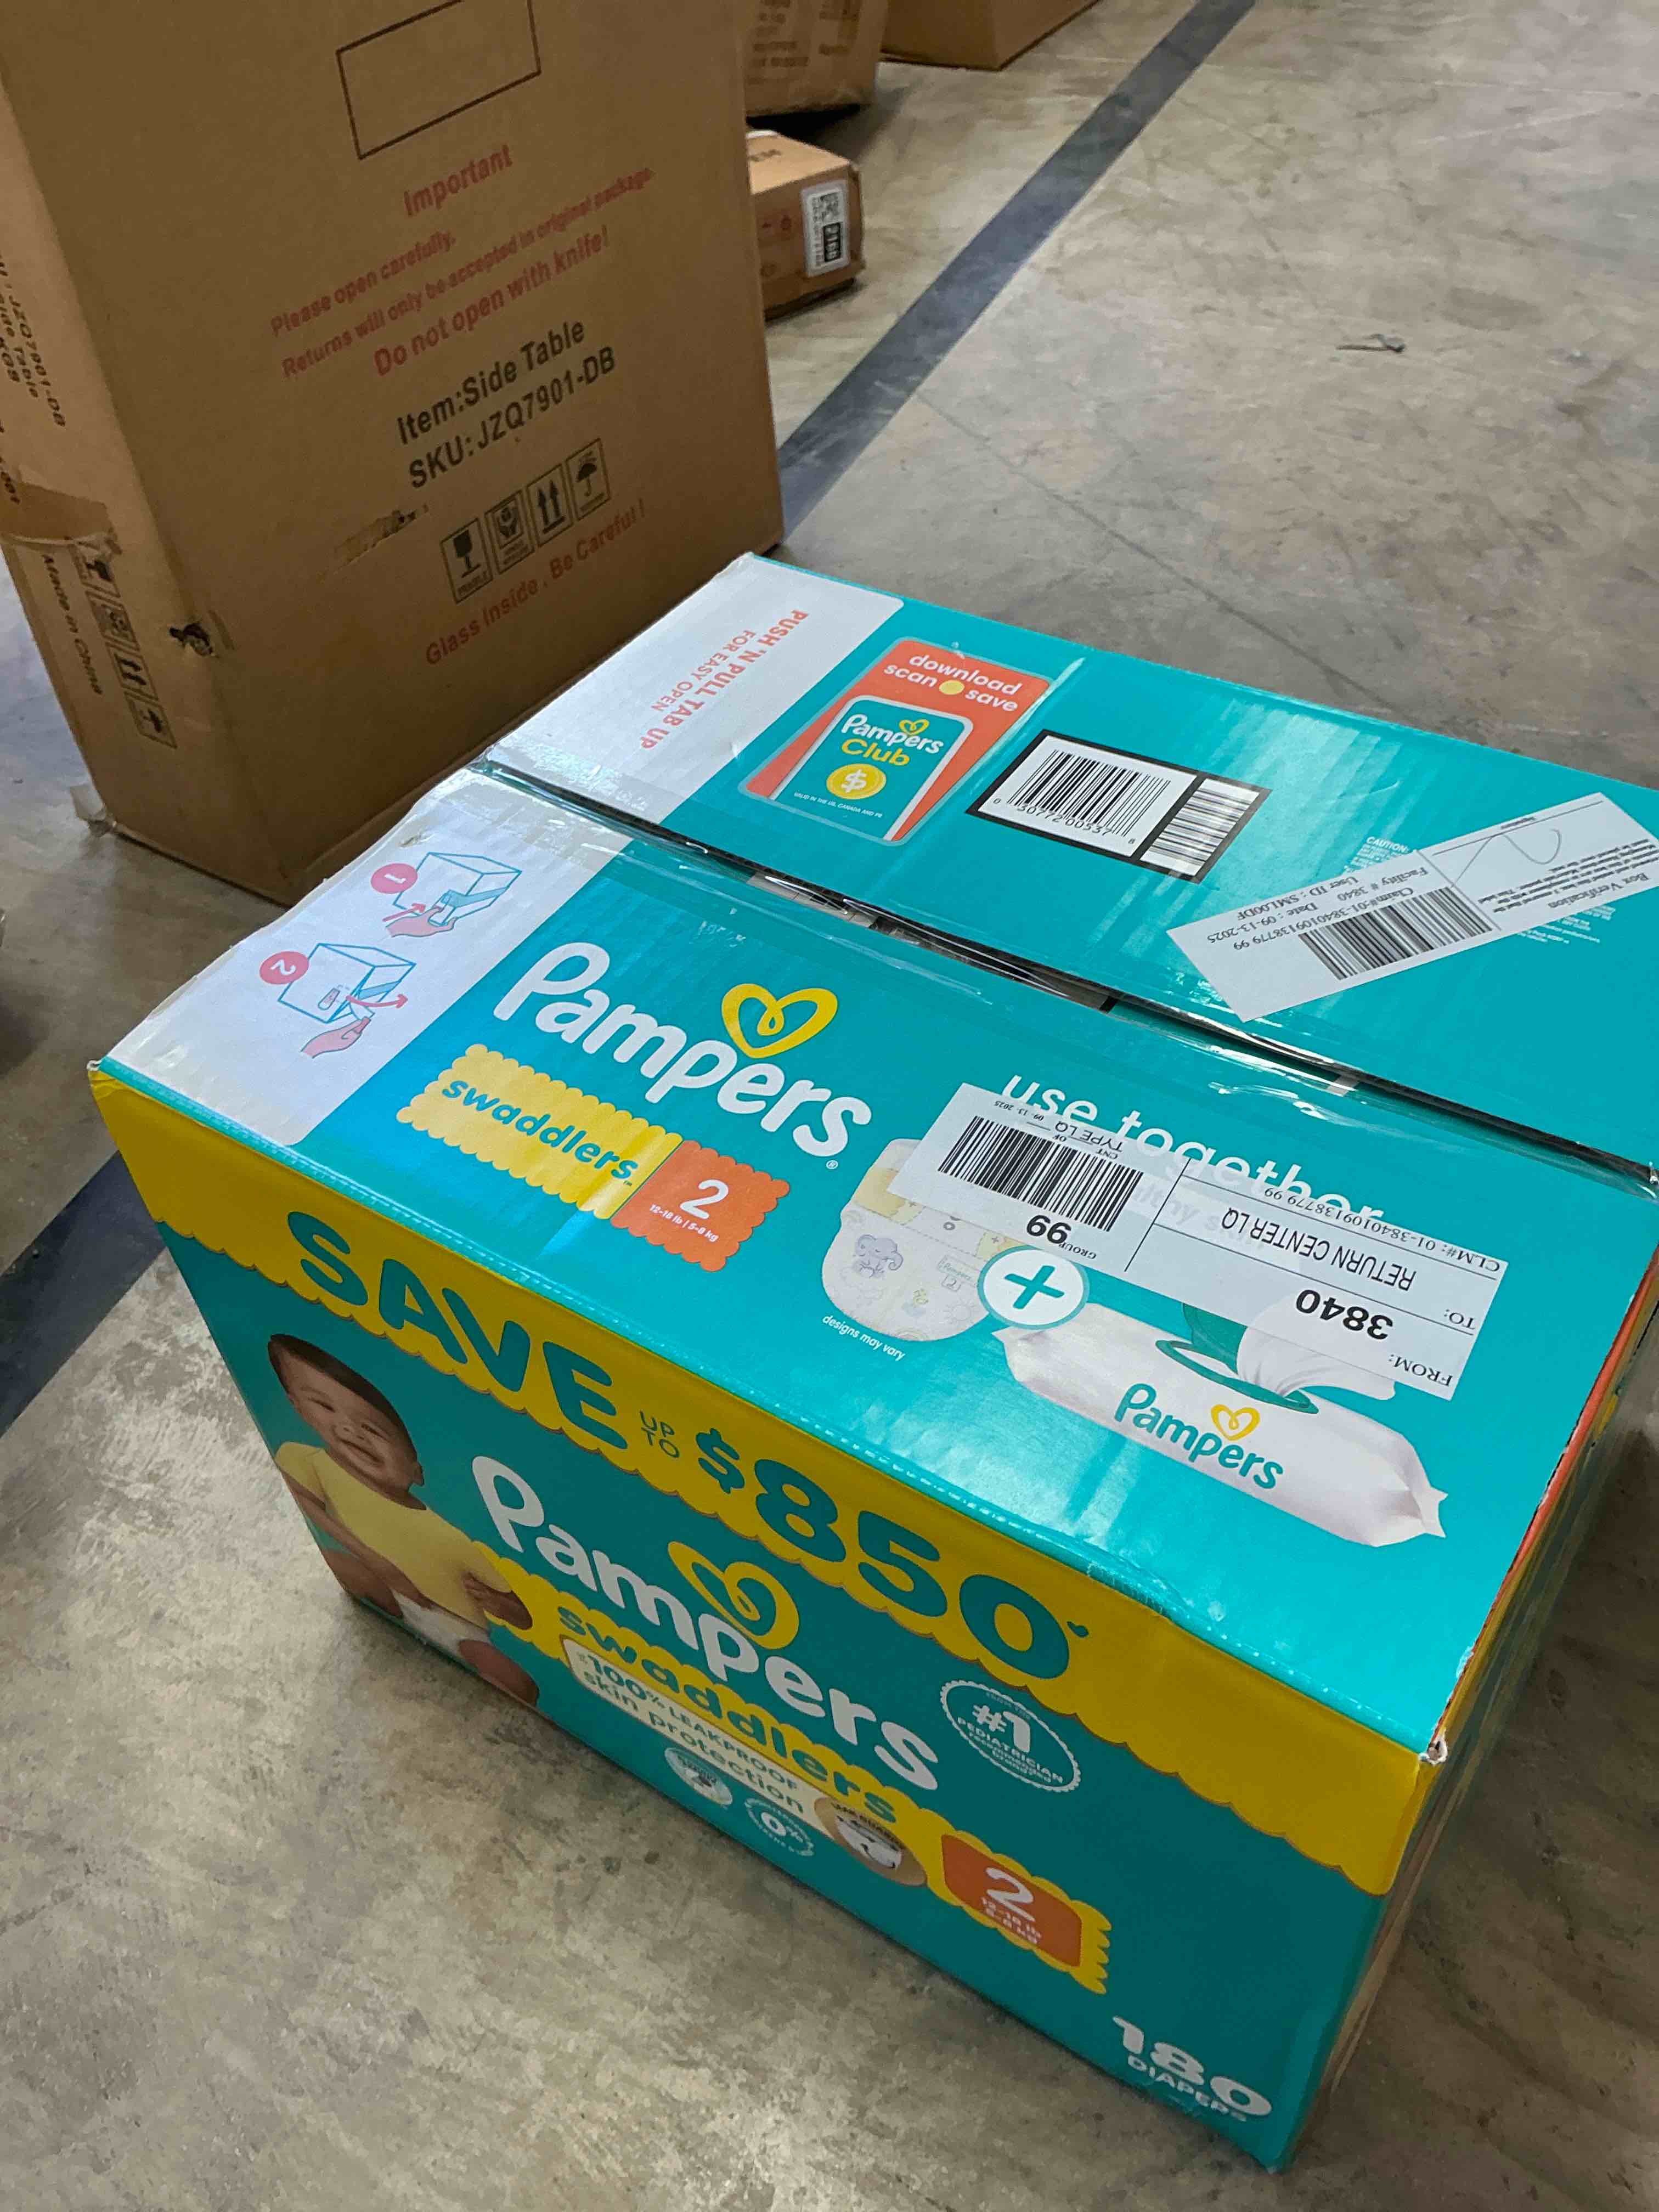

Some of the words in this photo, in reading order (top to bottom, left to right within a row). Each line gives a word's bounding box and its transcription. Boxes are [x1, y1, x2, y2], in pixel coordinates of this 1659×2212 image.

[404, 144, 513, 216] Important
[271, 296, 331, 337] Please
[334, 271, 377, 303] open
[281, 330, 353, 377] Returns
[355, 308, 386, 337] will
[387, 292, 422, 322] only
[425, 279, 446, 300] be
[448, 234, 517, 287] accepted
[374, 345, 407, 376] Do
[412, 317, 449, 356] not
[452, 289, 504, 331] open
[507, 260, 552, 300] with
[553, 224, 609, 274] knife!
[521, 320, 585, 373] Table
[426, 617, 480, 664] Glass
[483, 579, 538, 627] Inside
[549, 556, 573, 580] Be
[721, 629, 756, 651] FOR
[757, 609, 810, 646] PUSH
[690, 652, 727, 680] EASY
[695, 662, 746, 696] PULL
[909, 653, 1023, 696] download
[651, 681, 693, 712] OPEN
[883, 663, 939, 688] scan
[964, 689, 1018, 712] save
[663, 699, 706, 727] TAB
[640, 727, 670, 749] UP
[841, 713, 945, 754] Pampers
[841, 738, 910, 766] Club
[838, 803, 861, 813] CANADA
[1016, 803, 1063, 823] 30772
[1309, 886, 1328, 897] ID
[1329, 876, 1359, 890] User
[1380, 867, 1429, 887] Facility
[1625, 872, 1650, 885] Box
[1288, 901, 1318, 916] Date
[1337, 888, 1369, 901] 3840
[1548, 882, 1623, 909] Verification
[1206, 915, 1278, 944] 09-13-2025
[1233, 937, 1250, 951] 99
[270, 959, 296, 975] 2
[493, 941, 872, 1157] Pampers
[994, 1099, 1014, 1111] 2025
[1001, 1075, 1098, 1123] use
[442, 1079, 639, 1180] swaddlers
[1055, 1121, 1079, 1137] LQ
[1080, 1130, 1123, 1152] TYPE
[1096, 1148, 1119, 1160] CNT
[680, 1179, 729, 1219] 2
[1264, 1186, 1283, 1201] 99
[673, 1214, 684, 1224] lb
[704, 1229, 719, 1242] kg
[1026, 1214, 1071, 1245] 99
[1221, 1207, 1250, 1234] LQ
[1058, 1242, 1098, 1259] GROUP
[1249, 1218, 1330, 1262] CENTER
[1330, 1245, 1417, 1291] RETURN
[1443, 1241, 1501, 1273] CLM#:
[287, 1211, 628, 1449] SAVE
[1295, 1288, 1394, 1340] 3840
[1444, 1308, 1476, 1330] TO:
[822, 1314, 860, 1342] designs
[860, 1333, 883, 1351] may
[882, 1342, 906, 1361] vary
[1389, 1354, 1454, 1386] FROM:
[639, 1410, 675, 1437] UP
[1114, 1383, 1283, 1489] Pampers
[640, 1426, 680, 1458] TO
[471, 1455, 939, 1791] Pampers
[557, 1605, 897, 1824] swaddlers
[586, 1654, 663, 1709] 100%
[669, 1705, 798, 1790] LEAKPROOF
[972, 1704, 1031, 1753] #1
[583, 1671, 639, 1712] skin
[648, 1708, 805, 1815] protection
[985, 1867, 1035, 1922] 2
[1112, 2016, 1272, 2116] 180
